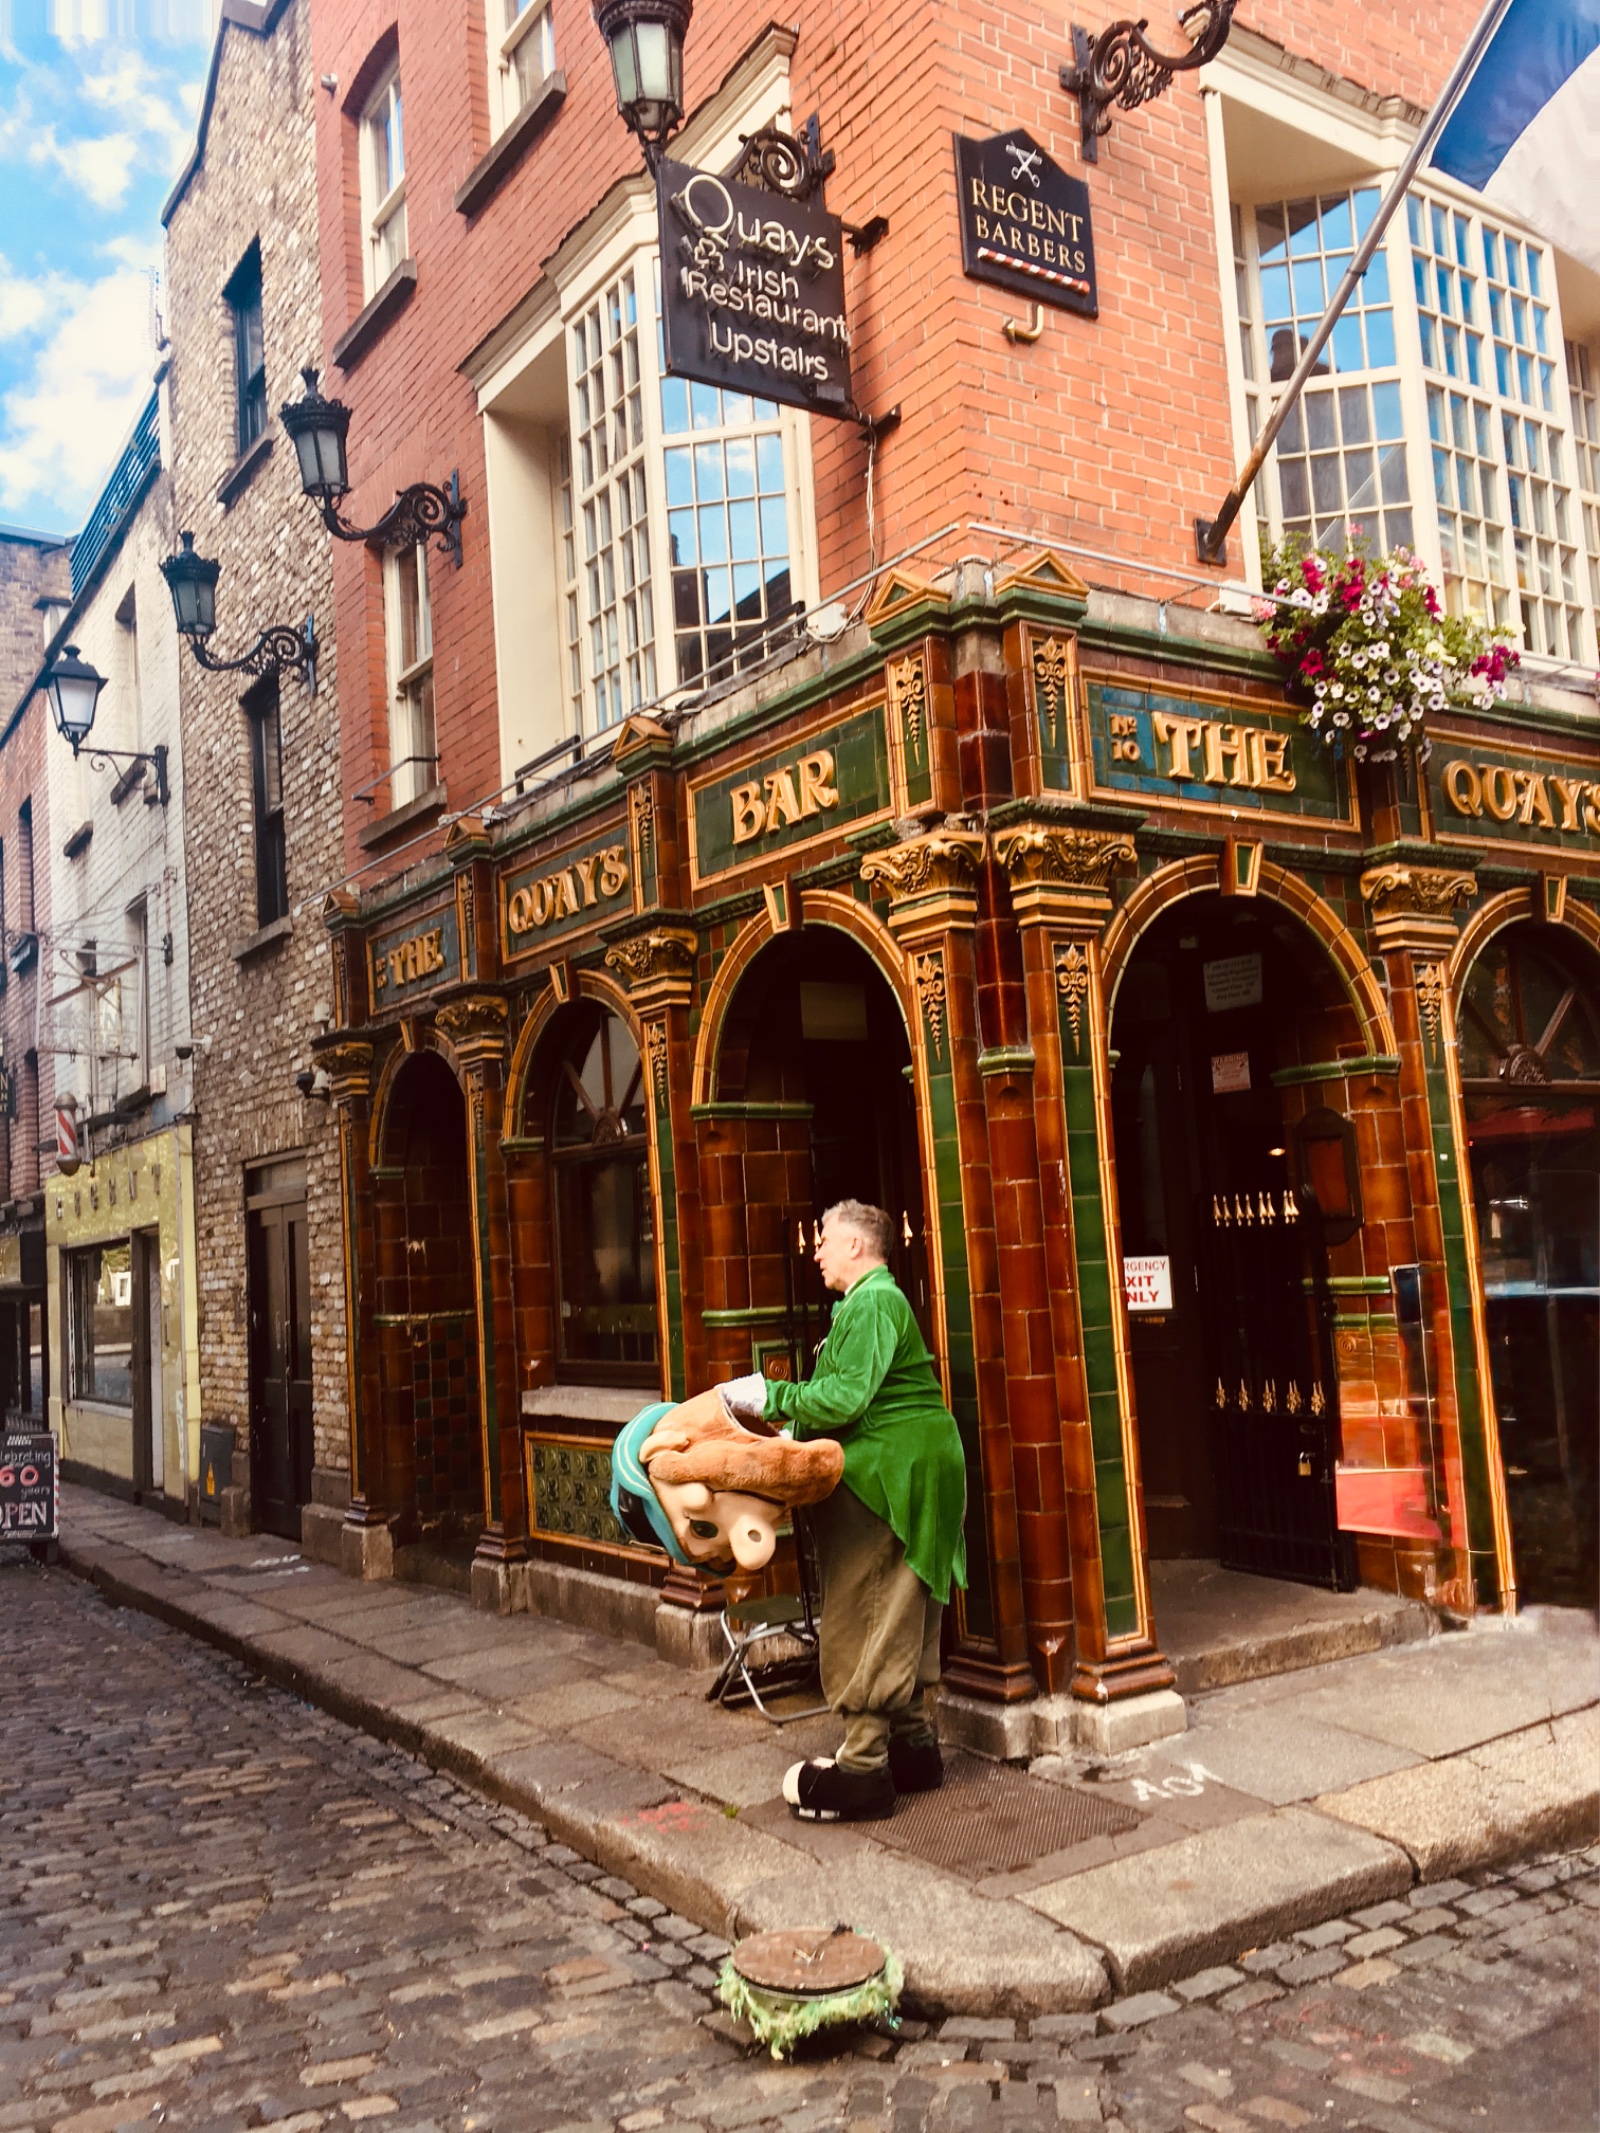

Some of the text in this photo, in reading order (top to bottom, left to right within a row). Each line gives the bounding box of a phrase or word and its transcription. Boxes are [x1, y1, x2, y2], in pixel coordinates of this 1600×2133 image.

[684, 174, 834, 269] Quays
[970, 177, 1083, 243] REGENT
[975, 214, 1086, 274] BARBERS
[685, 269, 849, 346] Restaurant
[737, 260, 800, 300] Irish
[711, 321, 829, 381] Upstairs
[1151, 710, 1296, 792] THE
[729, 749, 839, 845] BAR
[508, 844, 629, 934] QUAYS
[388, 926, 444, 986] THE
[1124, 1260, 1166, 1272] RGENCY
[1126, 1275, 1154, 1288] XIT
[1126, 1290, 1159, 1303] NLY
[0, 1450, 51, 1469] lebrating
[0, 1464, 39, 1488] 60
[0, 1501, 48, 1529] PEN
